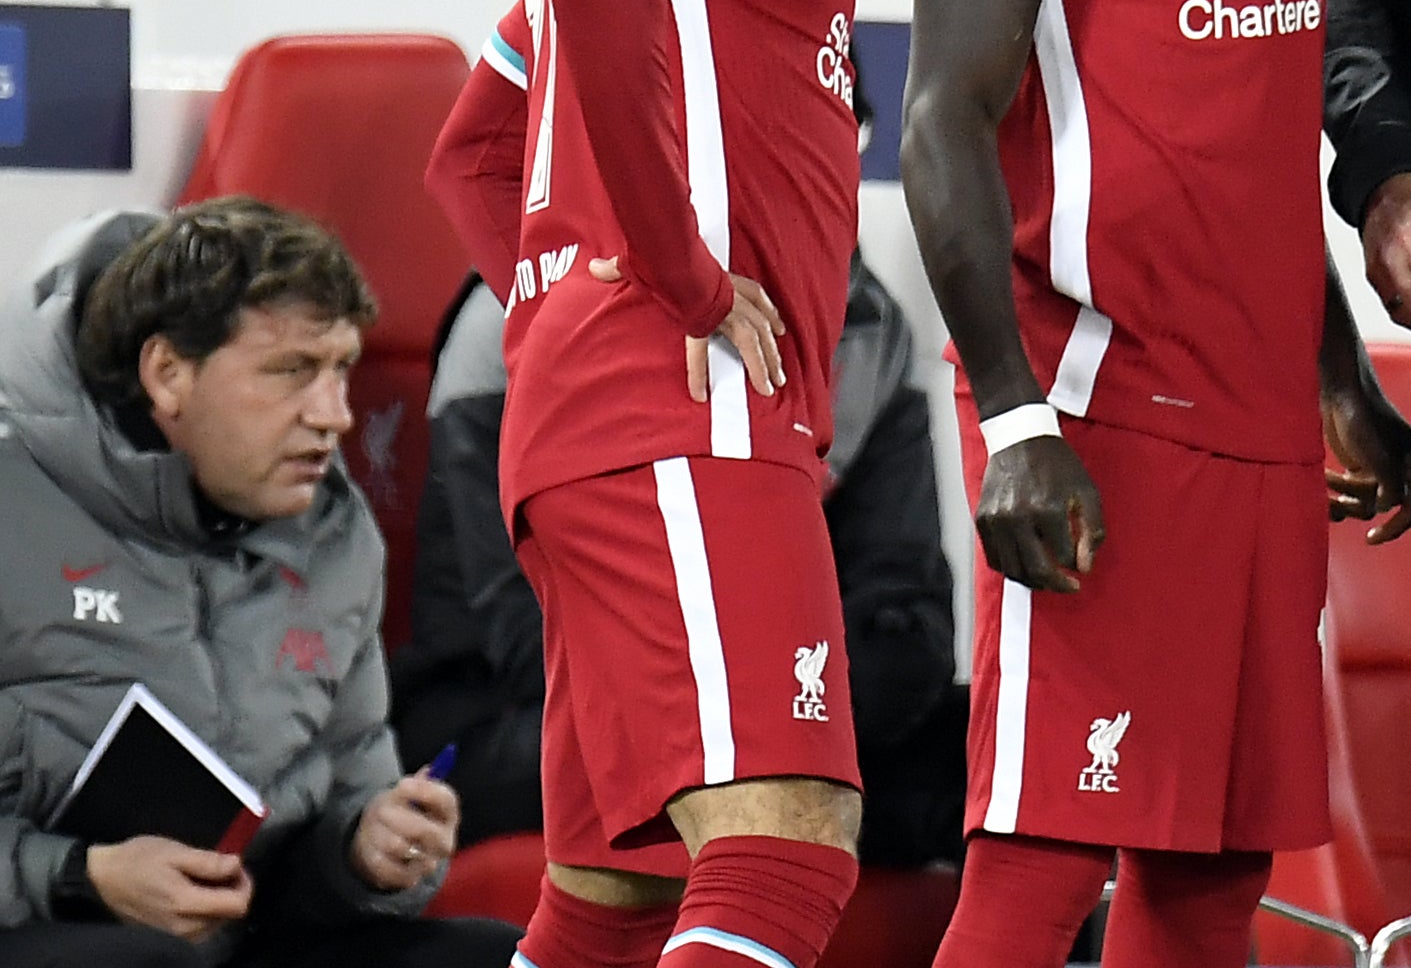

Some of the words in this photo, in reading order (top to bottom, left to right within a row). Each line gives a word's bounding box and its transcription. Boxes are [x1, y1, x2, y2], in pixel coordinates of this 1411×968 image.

[816, 46, 853, 111] Cha
[515, 258, 537, 302] TO
[73, 586, 121, 624] PK
